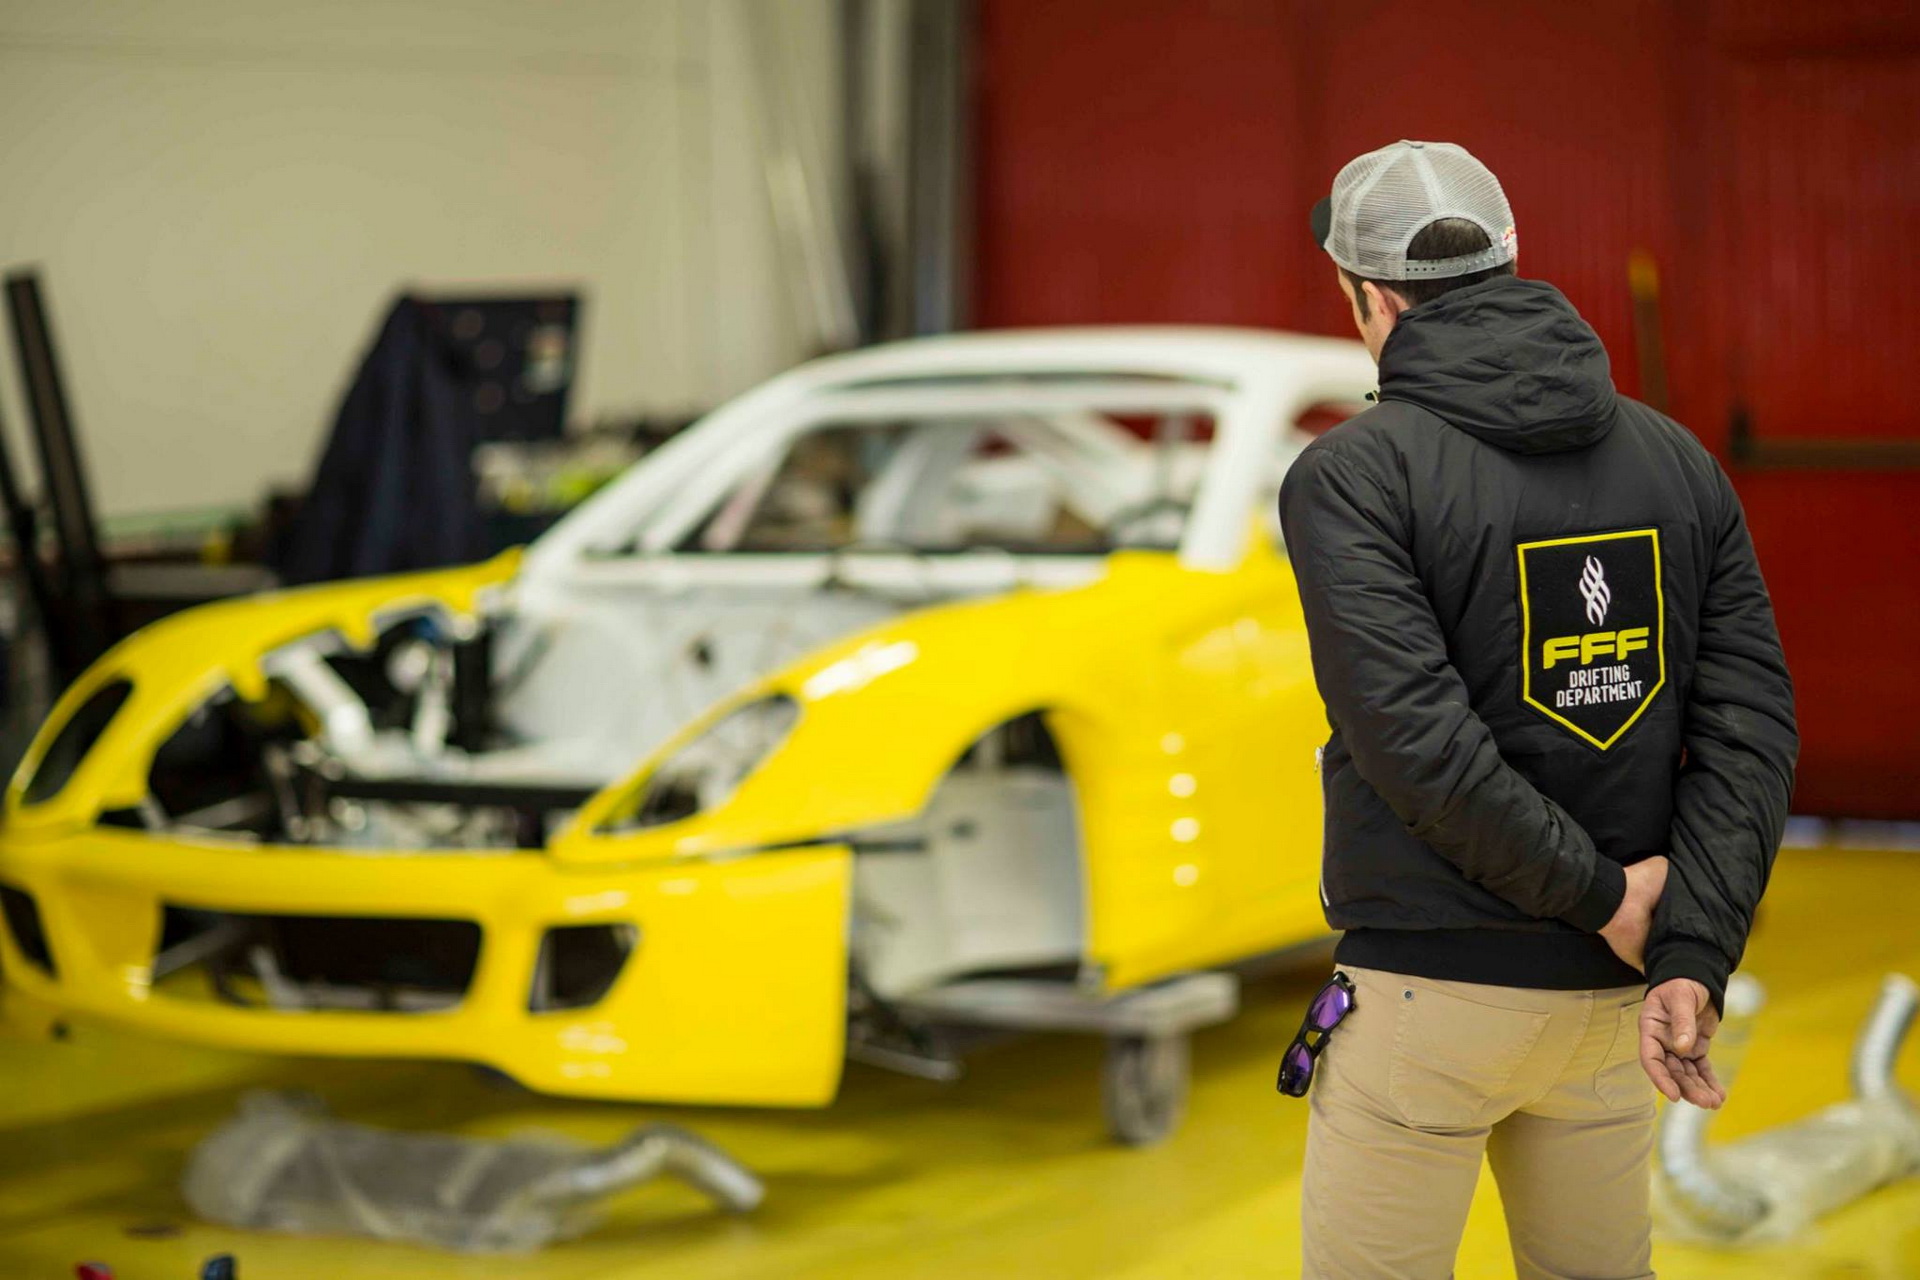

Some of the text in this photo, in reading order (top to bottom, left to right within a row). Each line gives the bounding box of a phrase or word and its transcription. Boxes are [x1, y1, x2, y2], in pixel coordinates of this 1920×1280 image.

[1543, 626, 1649, 670] FFF
[1569, 664, 1630, 688] DRIFTING
[1556, 680, 1642, 708] DEPARTMENT
